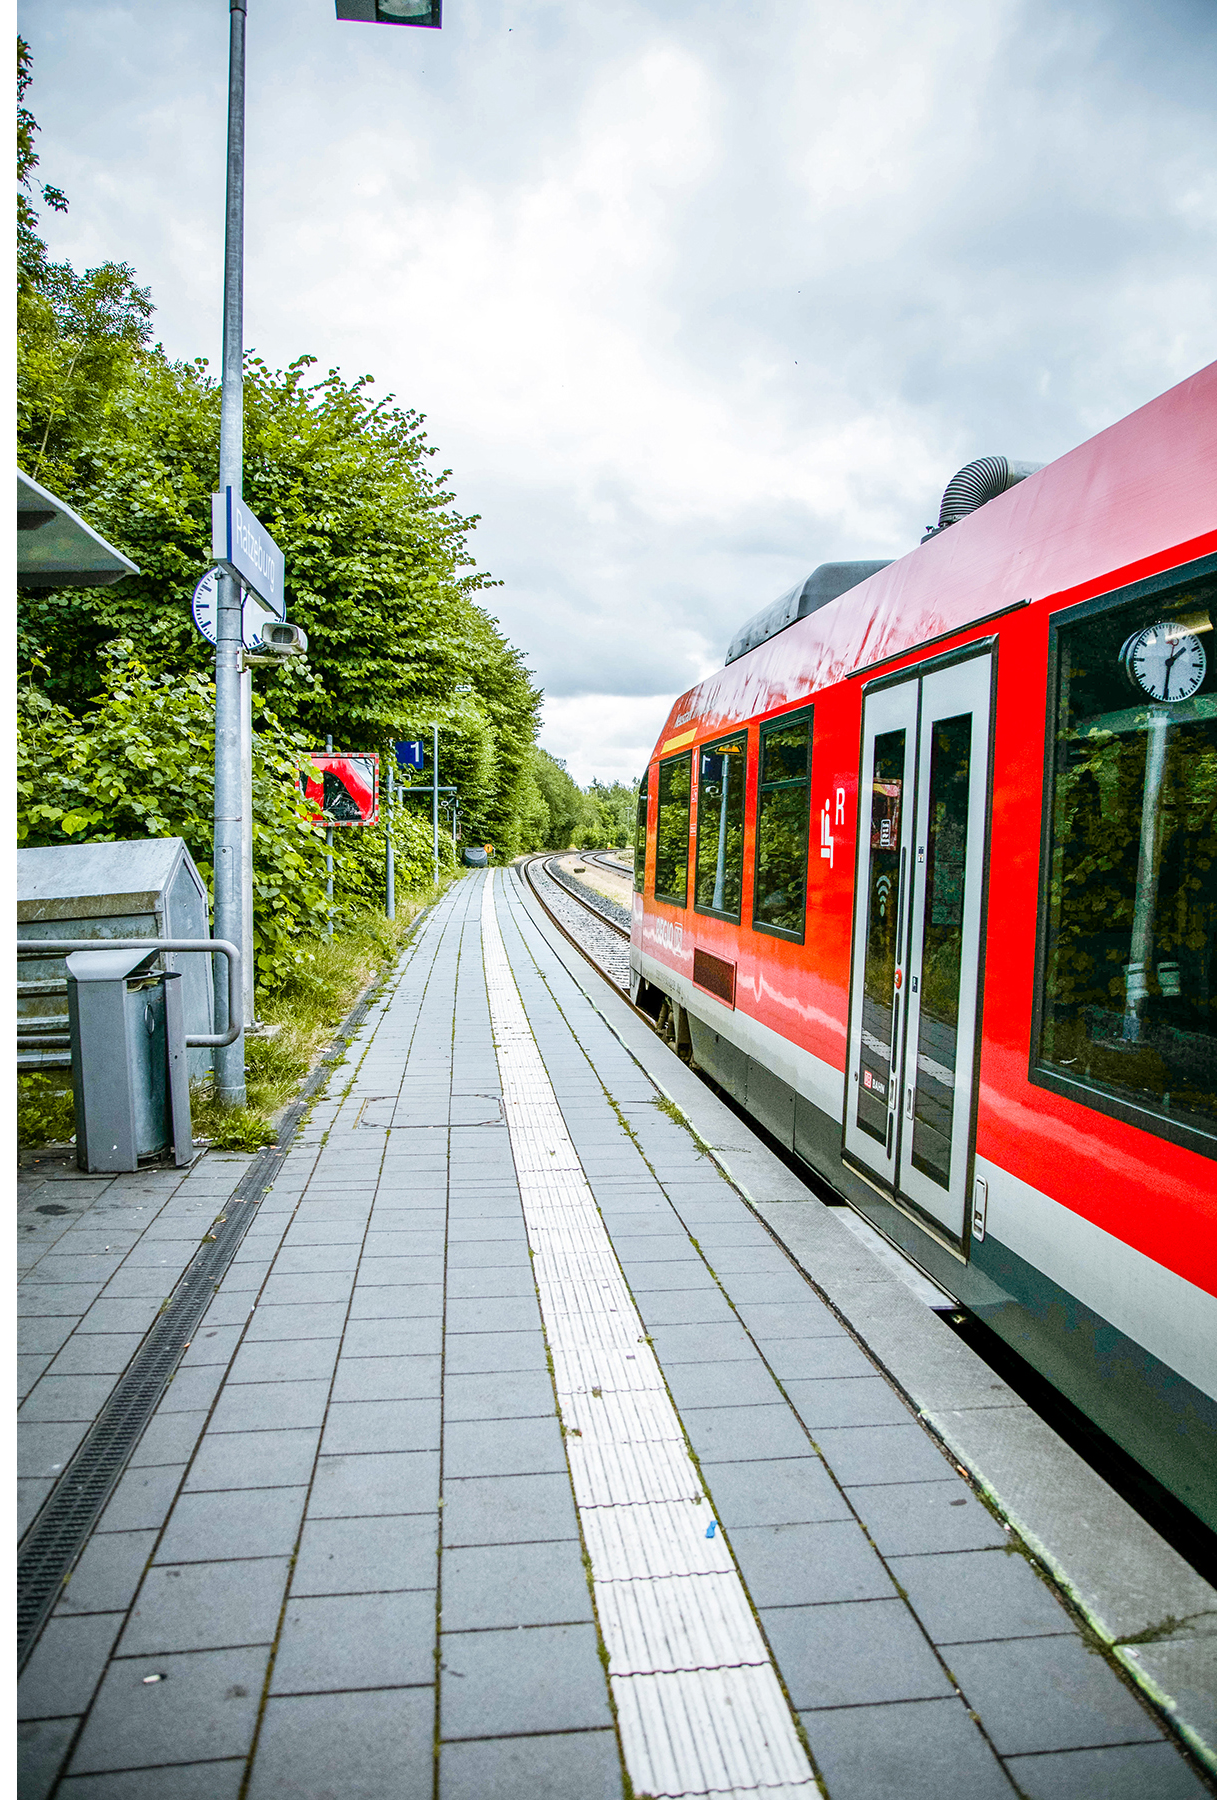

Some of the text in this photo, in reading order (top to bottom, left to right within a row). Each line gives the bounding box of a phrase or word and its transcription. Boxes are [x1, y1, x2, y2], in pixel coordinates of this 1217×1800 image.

[236, 507, 275, 593] Ratzeburg
[410, 741, 420, 762] 1
[693, 749, 698, 784] 1
[835, 787, 845, 825] R
[873, 1078, 885, 1094] BAHN
